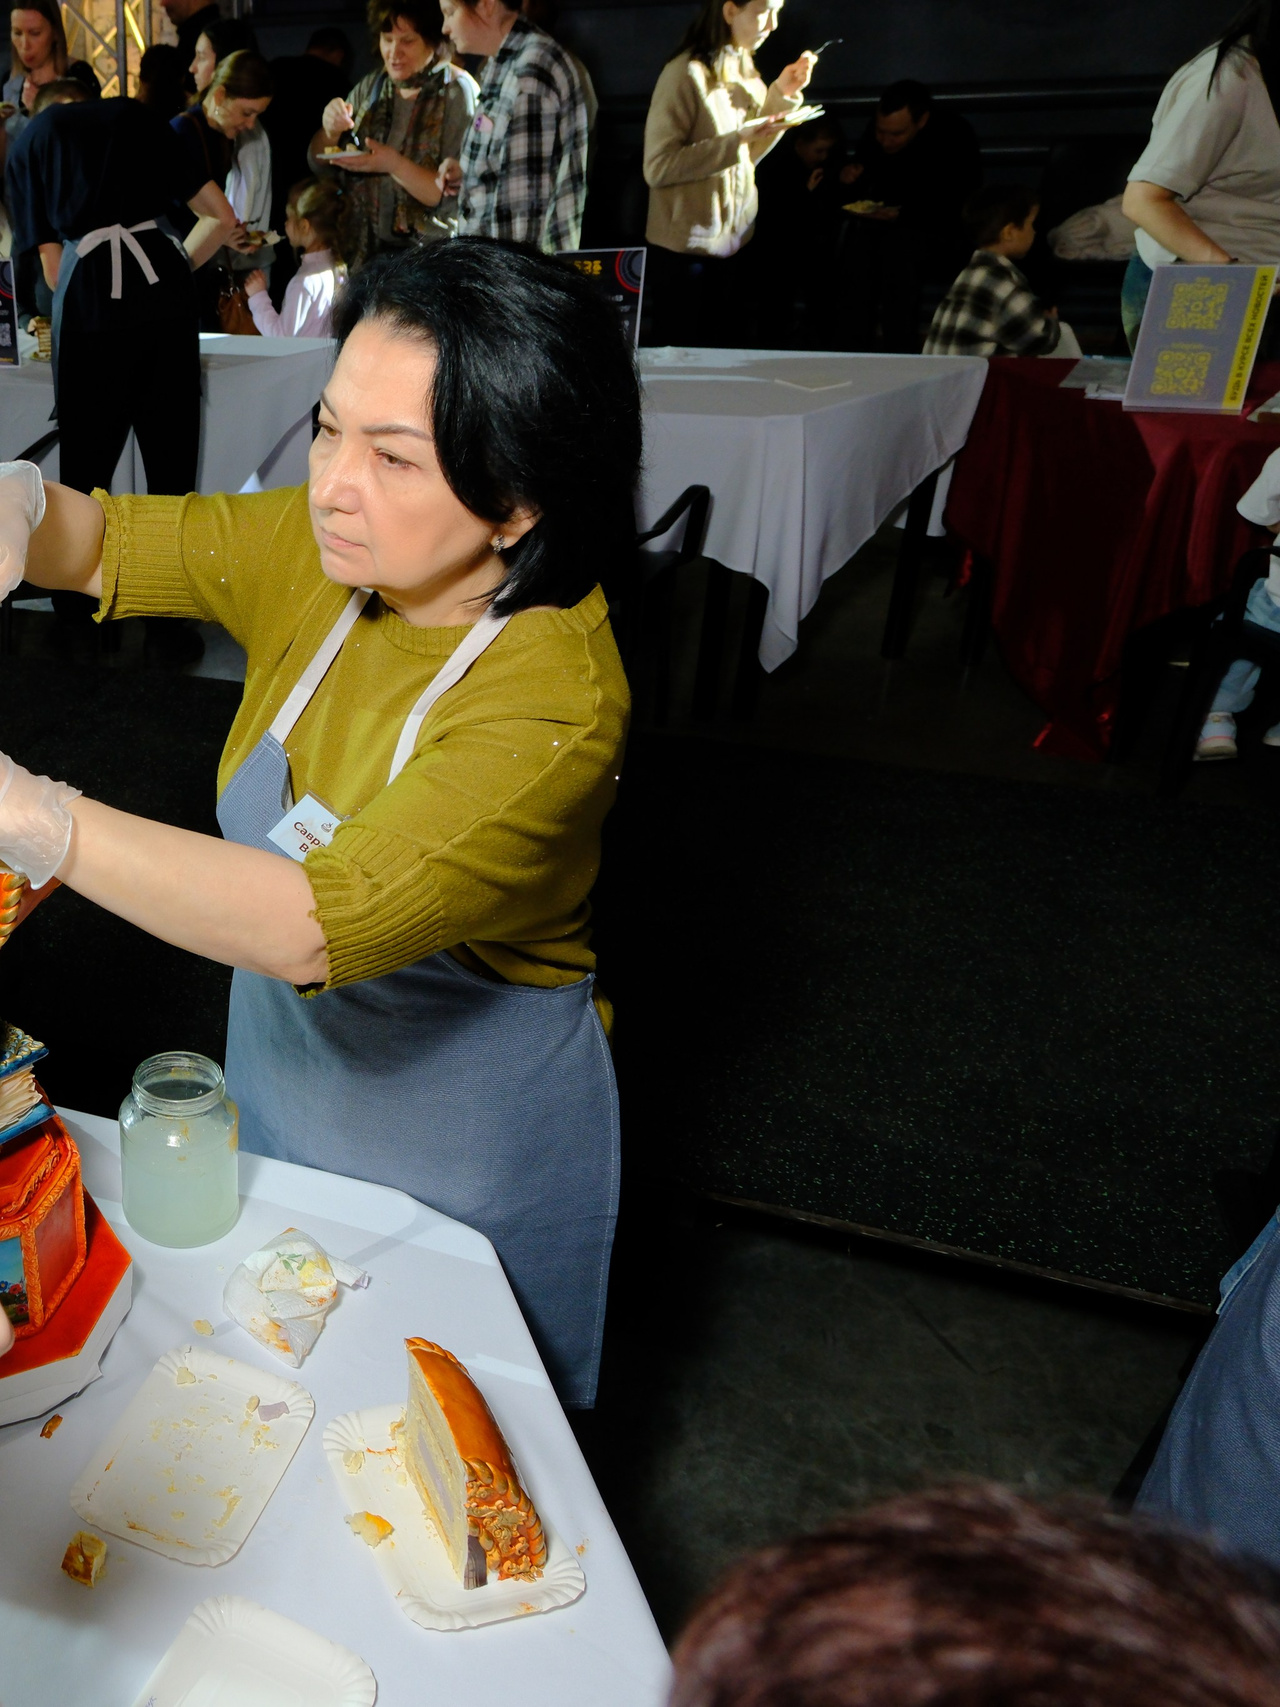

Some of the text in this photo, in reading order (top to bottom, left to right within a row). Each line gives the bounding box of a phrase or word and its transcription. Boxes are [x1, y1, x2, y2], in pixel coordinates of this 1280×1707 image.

[1230, 380, 1241, 401] БУДЬ
[1238, 345, 1250, 370] КУРСЕ
[1245, 322, 1257, 343] ВСЕХ
[1251, 274, 1268, 320] НОВОСТЕЙ
